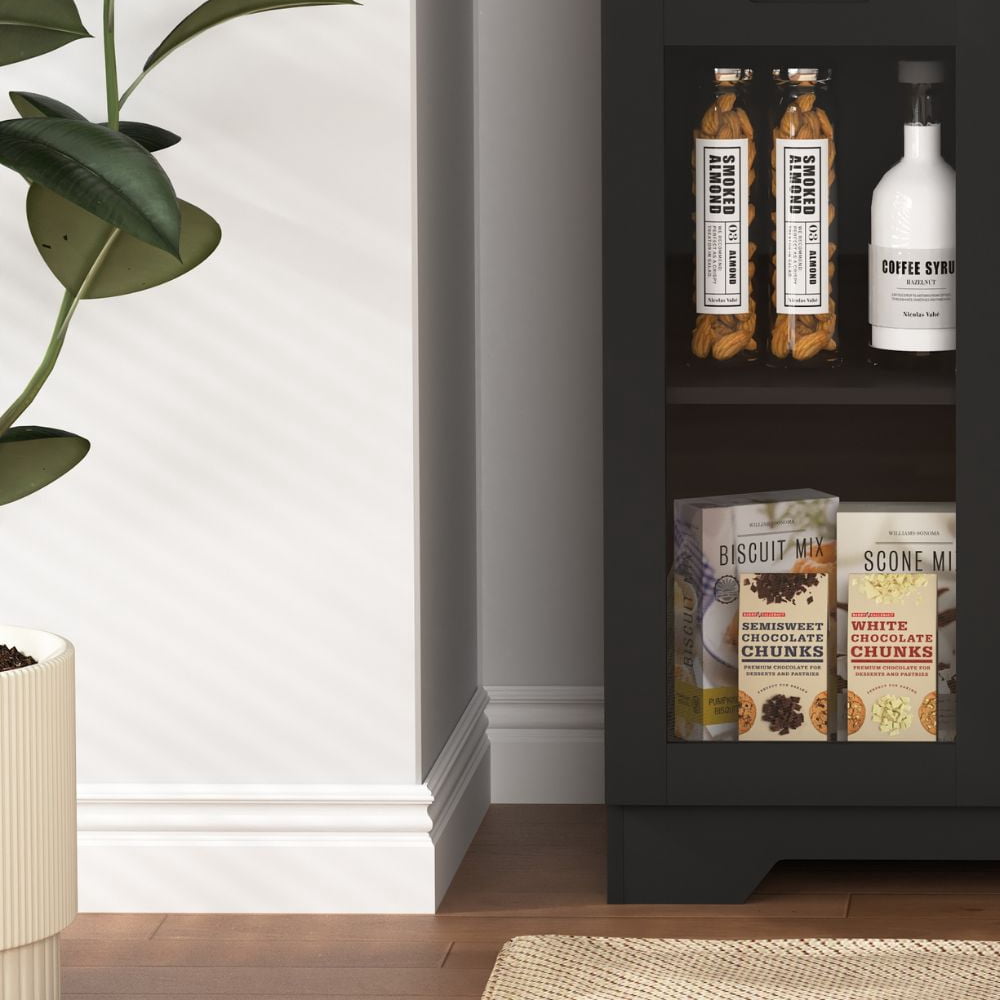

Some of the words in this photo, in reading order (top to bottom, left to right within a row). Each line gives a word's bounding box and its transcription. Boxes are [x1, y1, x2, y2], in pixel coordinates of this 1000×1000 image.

[709, 155, 721, 214] ALMOND
[723, 155, 735, 215] SMOKED
[789, 155, 801, 214] ALMOND
[803, 155, 815, 215] SMOKED
[728, 224, 738, 241] 03
[808, 224, 818, 241] 03
[882, 259, 920, 275] COFFEE
[925, 261, 955, 275] SYRU
[720, 540, 786, 566] BISCUIT
[796, 536, 824, 559] MIX
[864, 550, 923, 572] SCONE
[933, 551, 954, 572] MI
[683, 596, 694, 667] BISCUIT
[742, 622, 824, 630] SEMISWEET
[852, 621, 908, 630] WHITE
[742, 634, 824, 642] CHOCOLATE
[851, 634, 932, 642] CHOCOLATE
[742, 646, 824, 657] CHUNKS
[850, 646, 933, 658] CHUNKS
